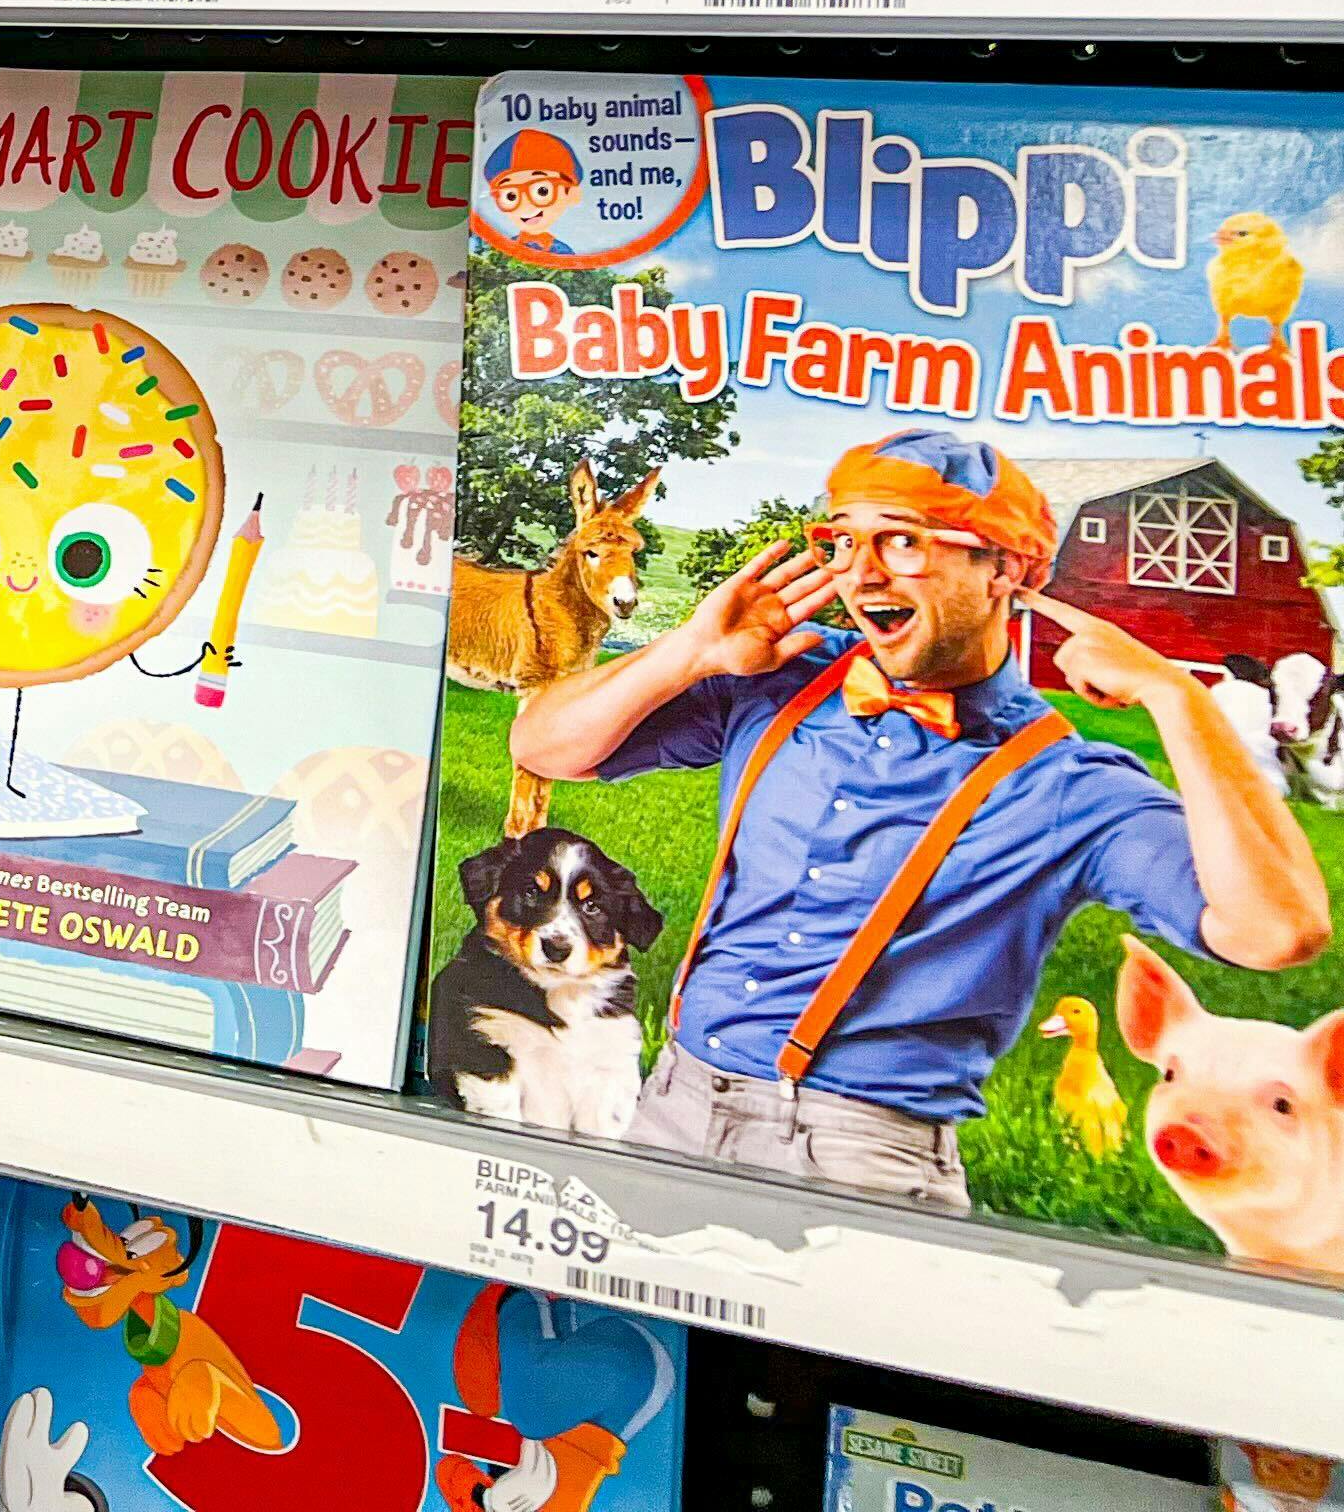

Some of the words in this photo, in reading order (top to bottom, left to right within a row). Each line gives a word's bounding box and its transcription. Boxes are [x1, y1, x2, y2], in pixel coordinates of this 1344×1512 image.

[500, 94, 532, 124] 10
[538, 95, 598, 130] baby
[603, 92, 683, 120] animal
[172, 104, 475, 210] COOKIE
[589, 162, 635, 190] and
[639, 162, 684, 194] me,
[596, 195, 645, 223] too!
[712, 106, 1188, 314] Blippi
[510, 285, 725, 400] Baby
[743, 293, 977, 416] Farm
[36, 874, 151, 918] Bestselling
[155, 896, 212, 924] Team
[59, 912, 201, 964] OSWALD
[477, 1200, 610, 1264] 14.99
[848, 1434, 905, 1464] SESAME
[907, 1445, 963, 1477] STREET
